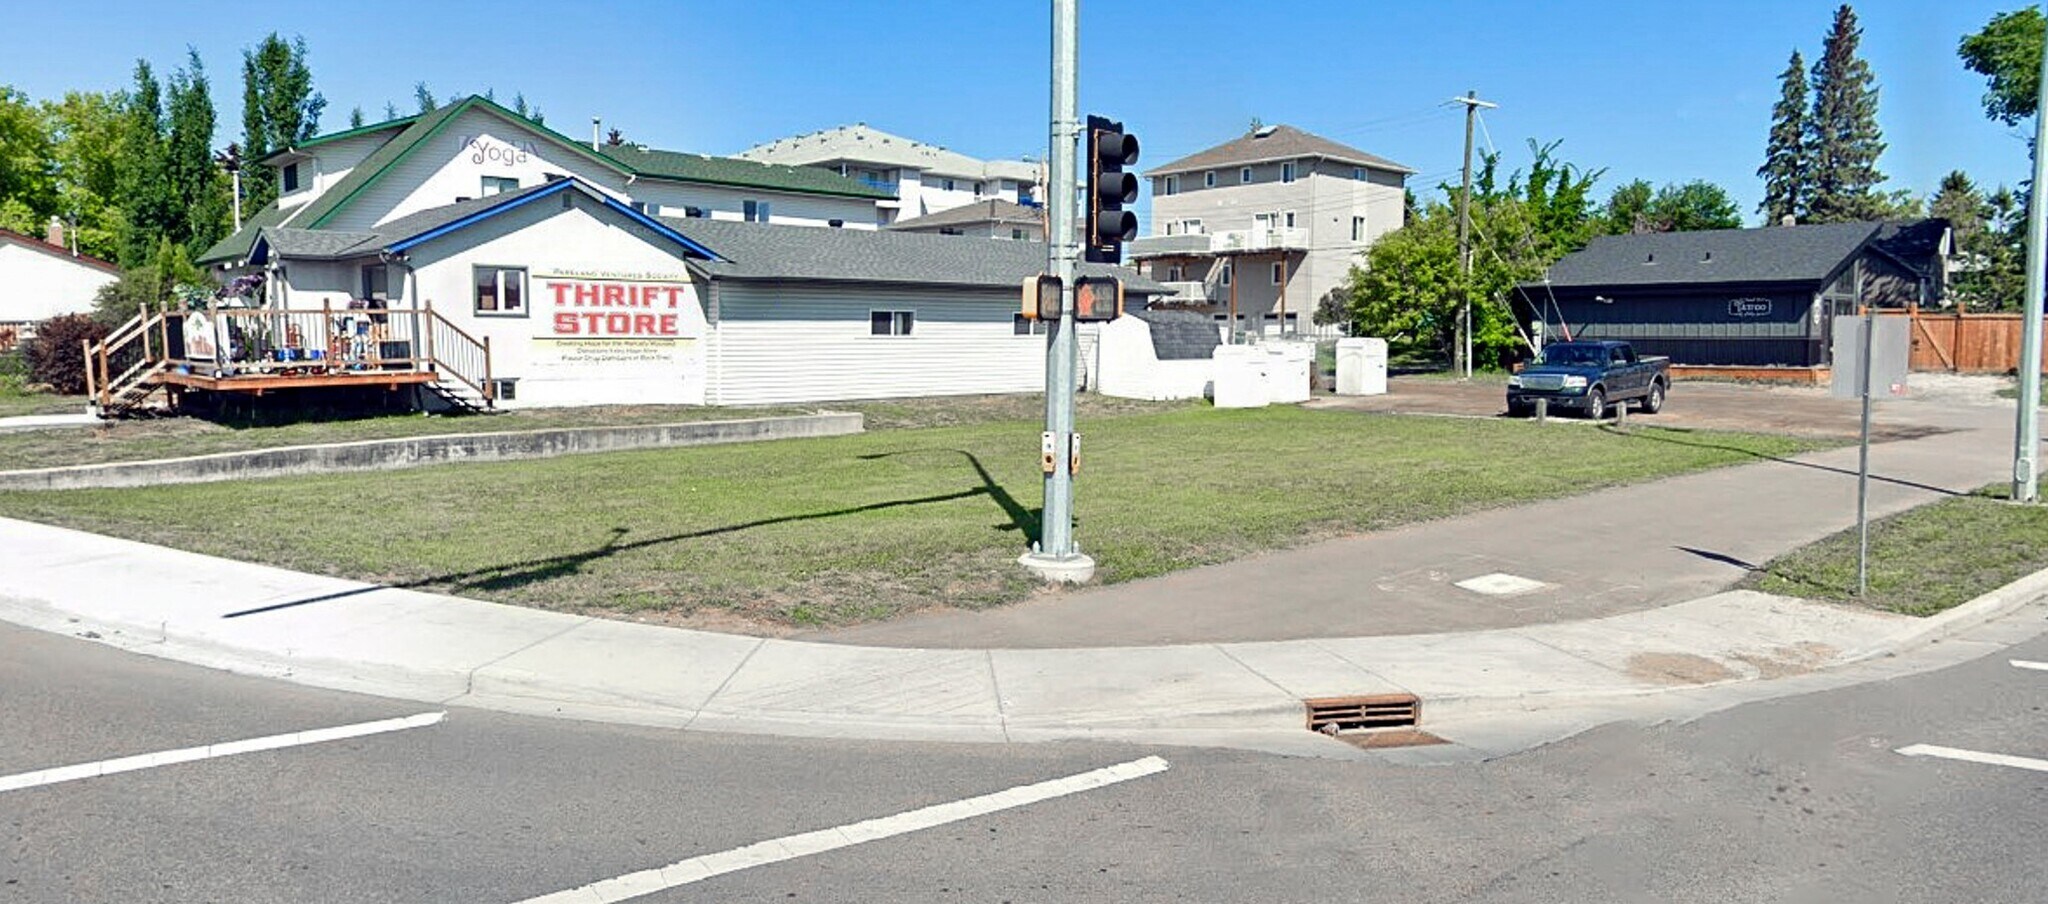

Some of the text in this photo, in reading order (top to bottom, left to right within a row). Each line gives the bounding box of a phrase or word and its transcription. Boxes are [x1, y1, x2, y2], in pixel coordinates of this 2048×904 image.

[470, 139, 527, 166] Yoga
[547, 282, 684, 308] THRIFT
[553, 311, 679, 335] STORE
